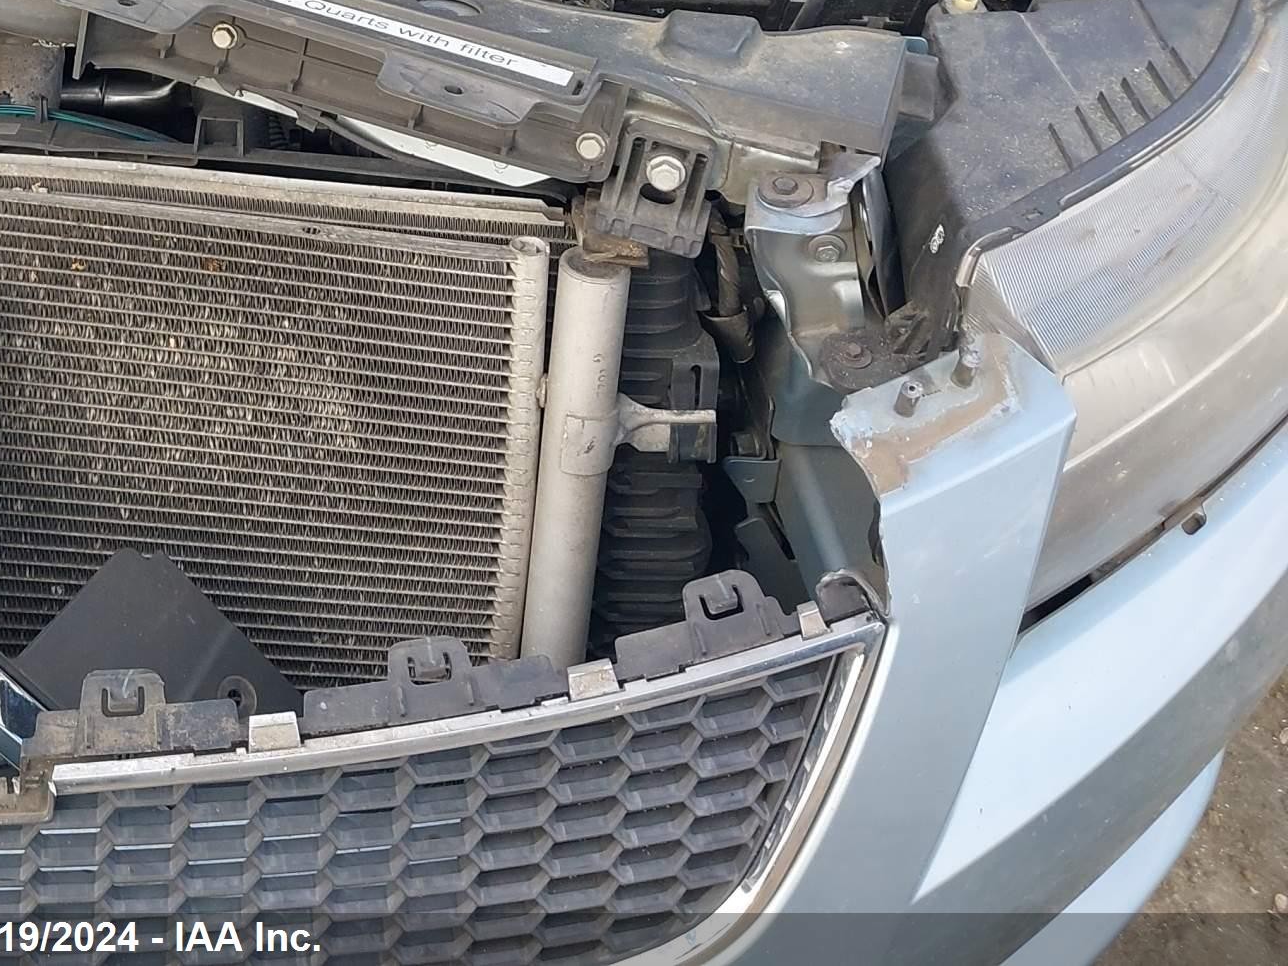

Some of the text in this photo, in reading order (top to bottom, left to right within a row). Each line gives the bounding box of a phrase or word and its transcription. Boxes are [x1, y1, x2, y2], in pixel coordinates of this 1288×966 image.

[304, 0, 389, 30] Quarts
[398, 25, 450, 48] with
[459, 42, 519, 67] filter
